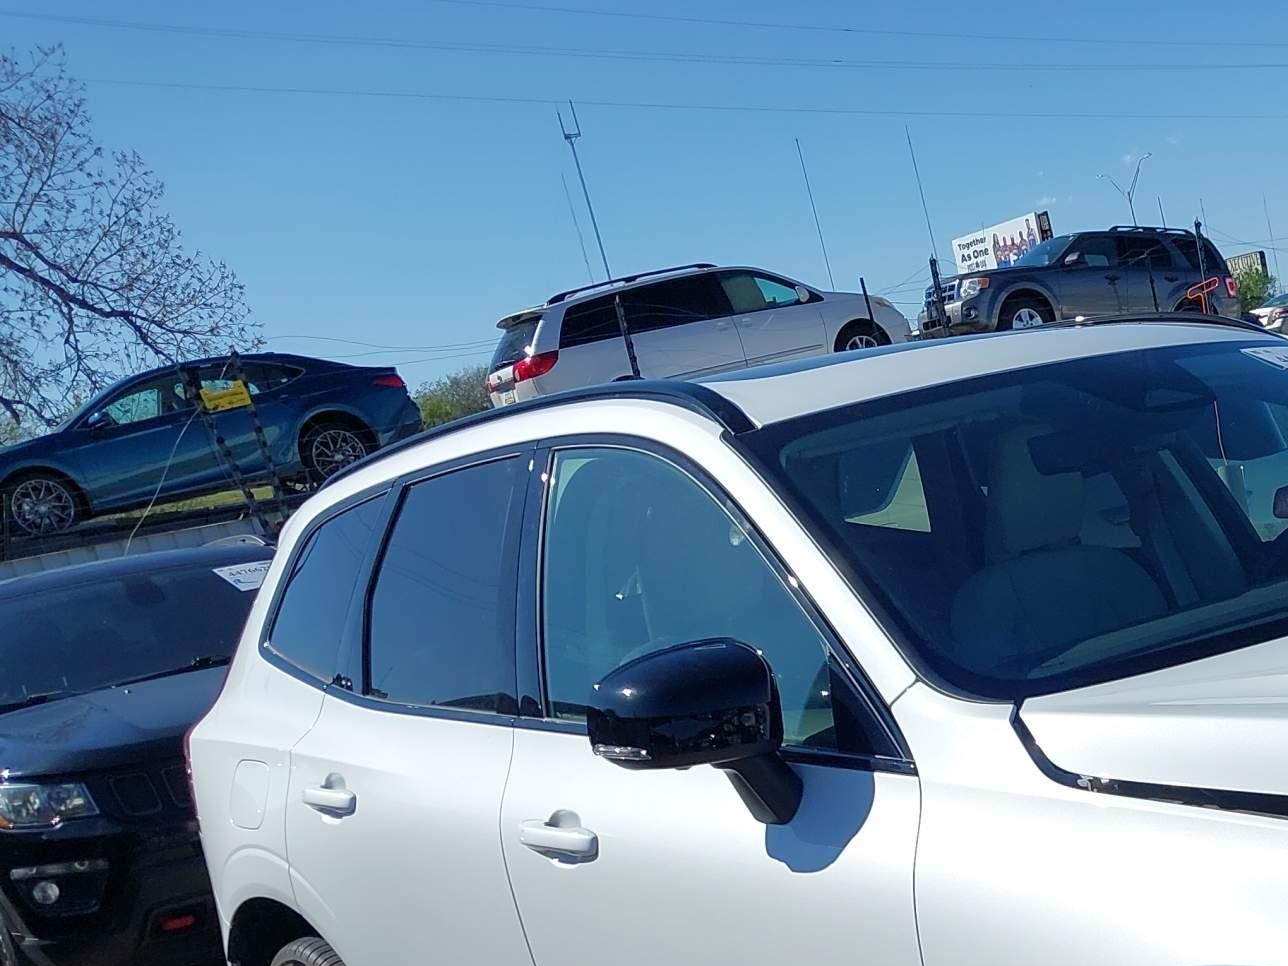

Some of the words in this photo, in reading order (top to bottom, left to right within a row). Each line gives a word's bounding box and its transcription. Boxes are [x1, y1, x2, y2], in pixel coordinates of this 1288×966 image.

[957, 236, 986, 251] Together
[961, 253, 972, 263] As
[972, 247, 990, 259] One
